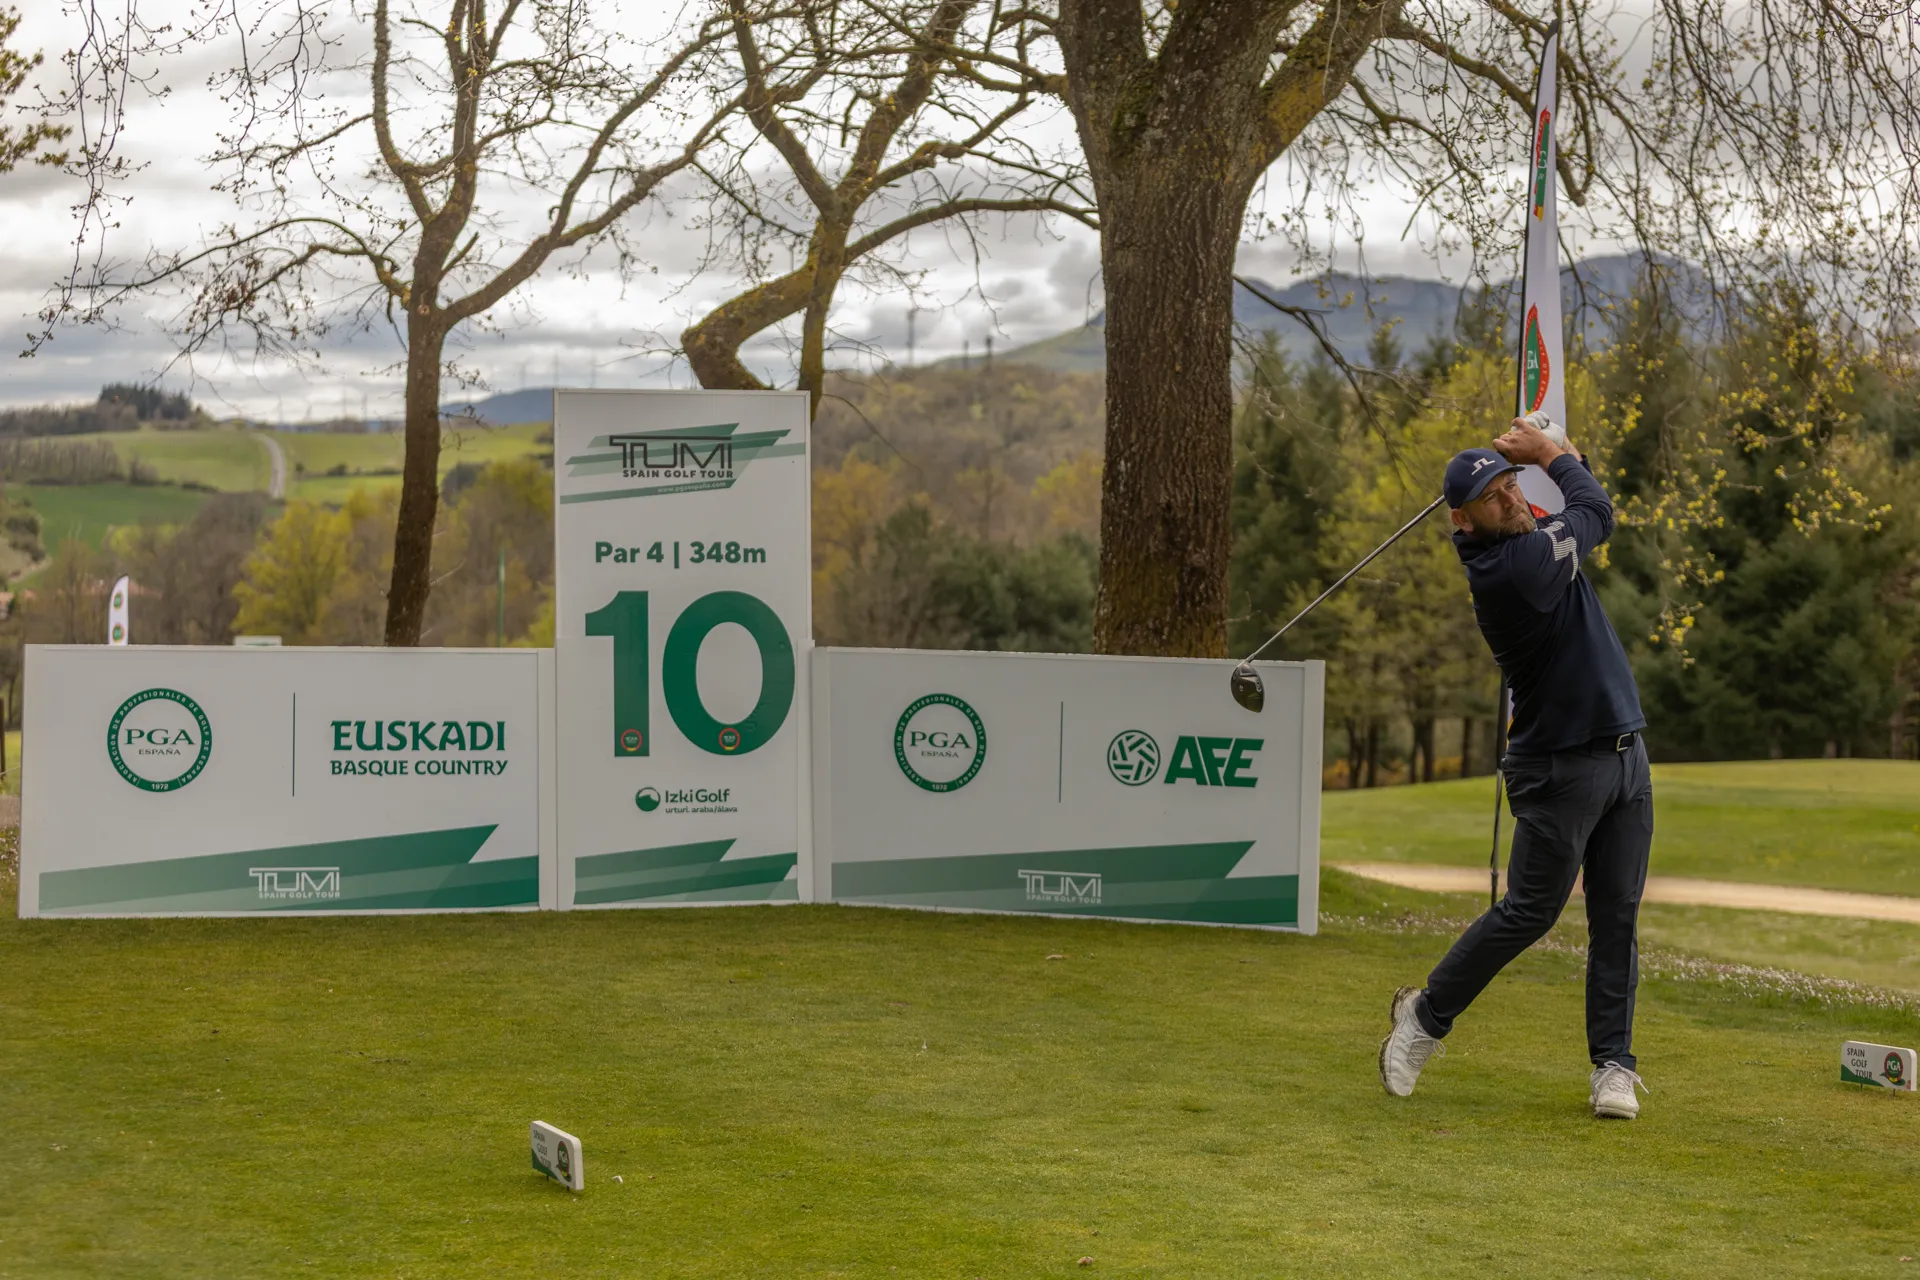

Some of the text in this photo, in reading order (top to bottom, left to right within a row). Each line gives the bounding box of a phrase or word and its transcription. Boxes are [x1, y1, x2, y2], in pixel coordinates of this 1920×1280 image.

[609, 435, 732, 469] TUMI
[623, 469, 734, 478] SPAIN GOLF TOUR
[595, 541, 640, 563] Par
[646, 541, 664, 563] 4
[689, 541, 766, 564] 348m
[584, 590, 796, 757] 10
[124, 728, 196, 745] PGA
[330, 720, 506, 751] EUSKADI
[908, 730, 972, 749] PGA
[921, 750, 959, 758] ESPAÑA
[1164, 735, 1265, 788] AFE
[330, 760, 508, 777] BASQUE COUNTRY
[249, 866, 340, 892] TUMI
[1018, 869, 1102, 897] TUMI
[1846, 1047, 1865, 1058] SPAIN
[1851, 1058, 1868, 1068] GOLF
[1887, 1060, 1901, 1071] PGA
[1855, 1069, 1873, 1079] TOUR
